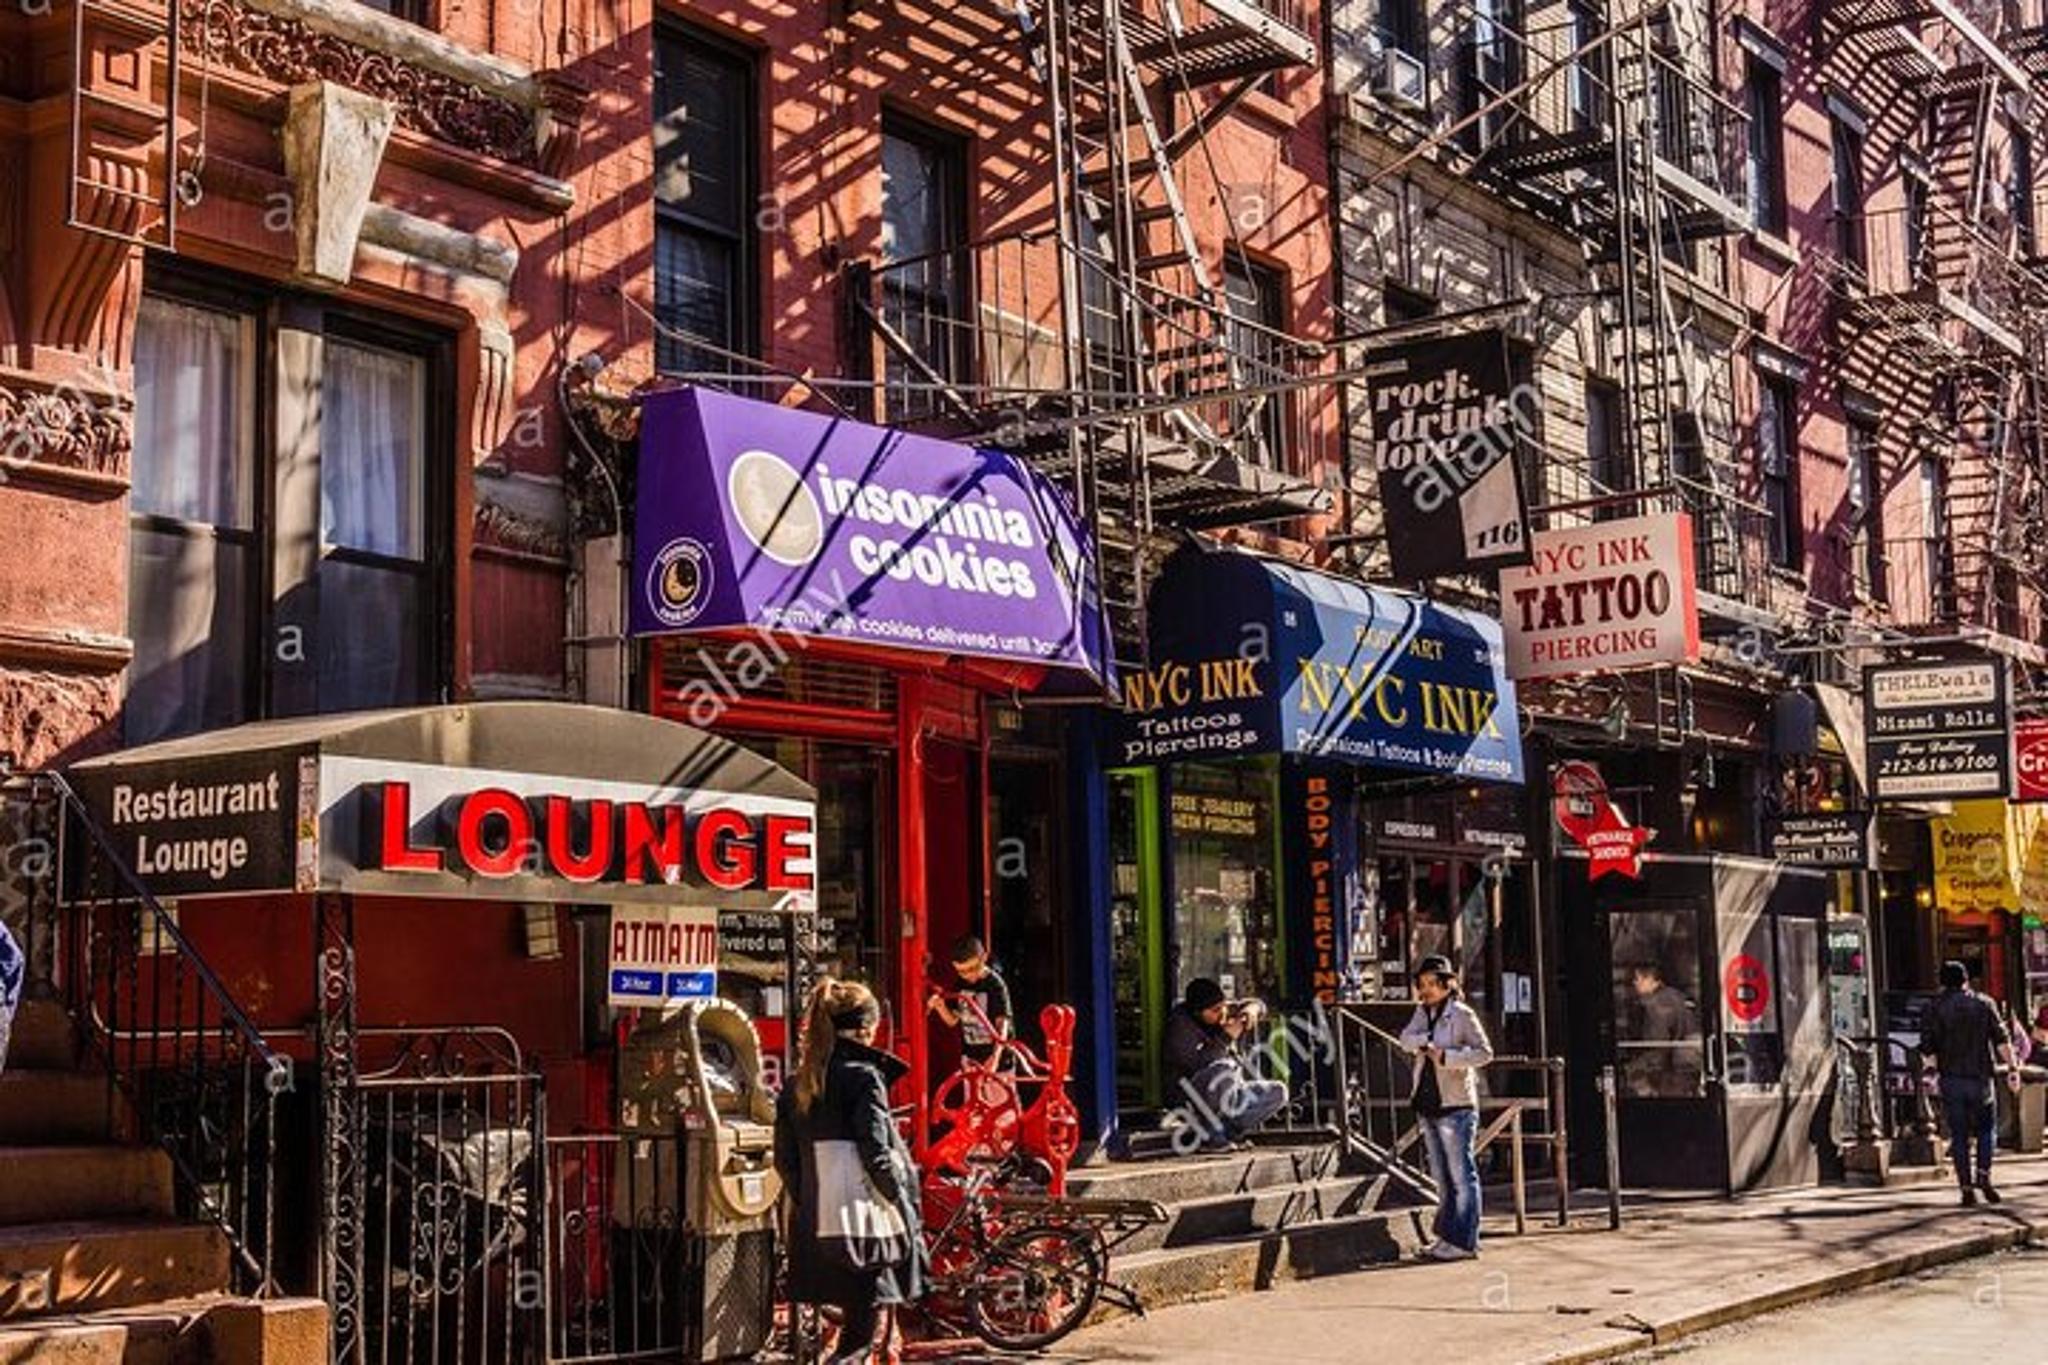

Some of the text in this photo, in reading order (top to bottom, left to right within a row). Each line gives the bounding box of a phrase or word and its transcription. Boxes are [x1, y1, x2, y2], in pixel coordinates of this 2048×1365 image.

[816, 462, 1033, 547] insomnia
[1477, 521, 1519, 550] 116
[1525, 534, 1652, 578] NYC INK
[849, 534, 1036, 599] cookies
[1513, 569, 1670, 632] TATTOO
[859, 619, 923, 641] cookies
[1410, 638, 1443, 661] ART
[1532, 628, 1657, 663] PIERCING
[1123, 658, 1263, 714] NYC INK
[1298, 656, 1504, 740] NYC INK
[1876, 670, 1991, 692] THELEwala
[1138, 713, 1242, 737] Tattoos
[1876, 709, 1995, 731] Nizami Rolls
[113, 771, 280, 824] Restaurant
[1306, 778, 1331, 849] BODY
[137, 835, 248, 880] Lounge
[380, 780, 815, 893] LOUNGE
[614, 921, 663, 962] ATM
[668, 923, 714, 965] ATM
[1311, 860, 1336, 1004] PIERCING
